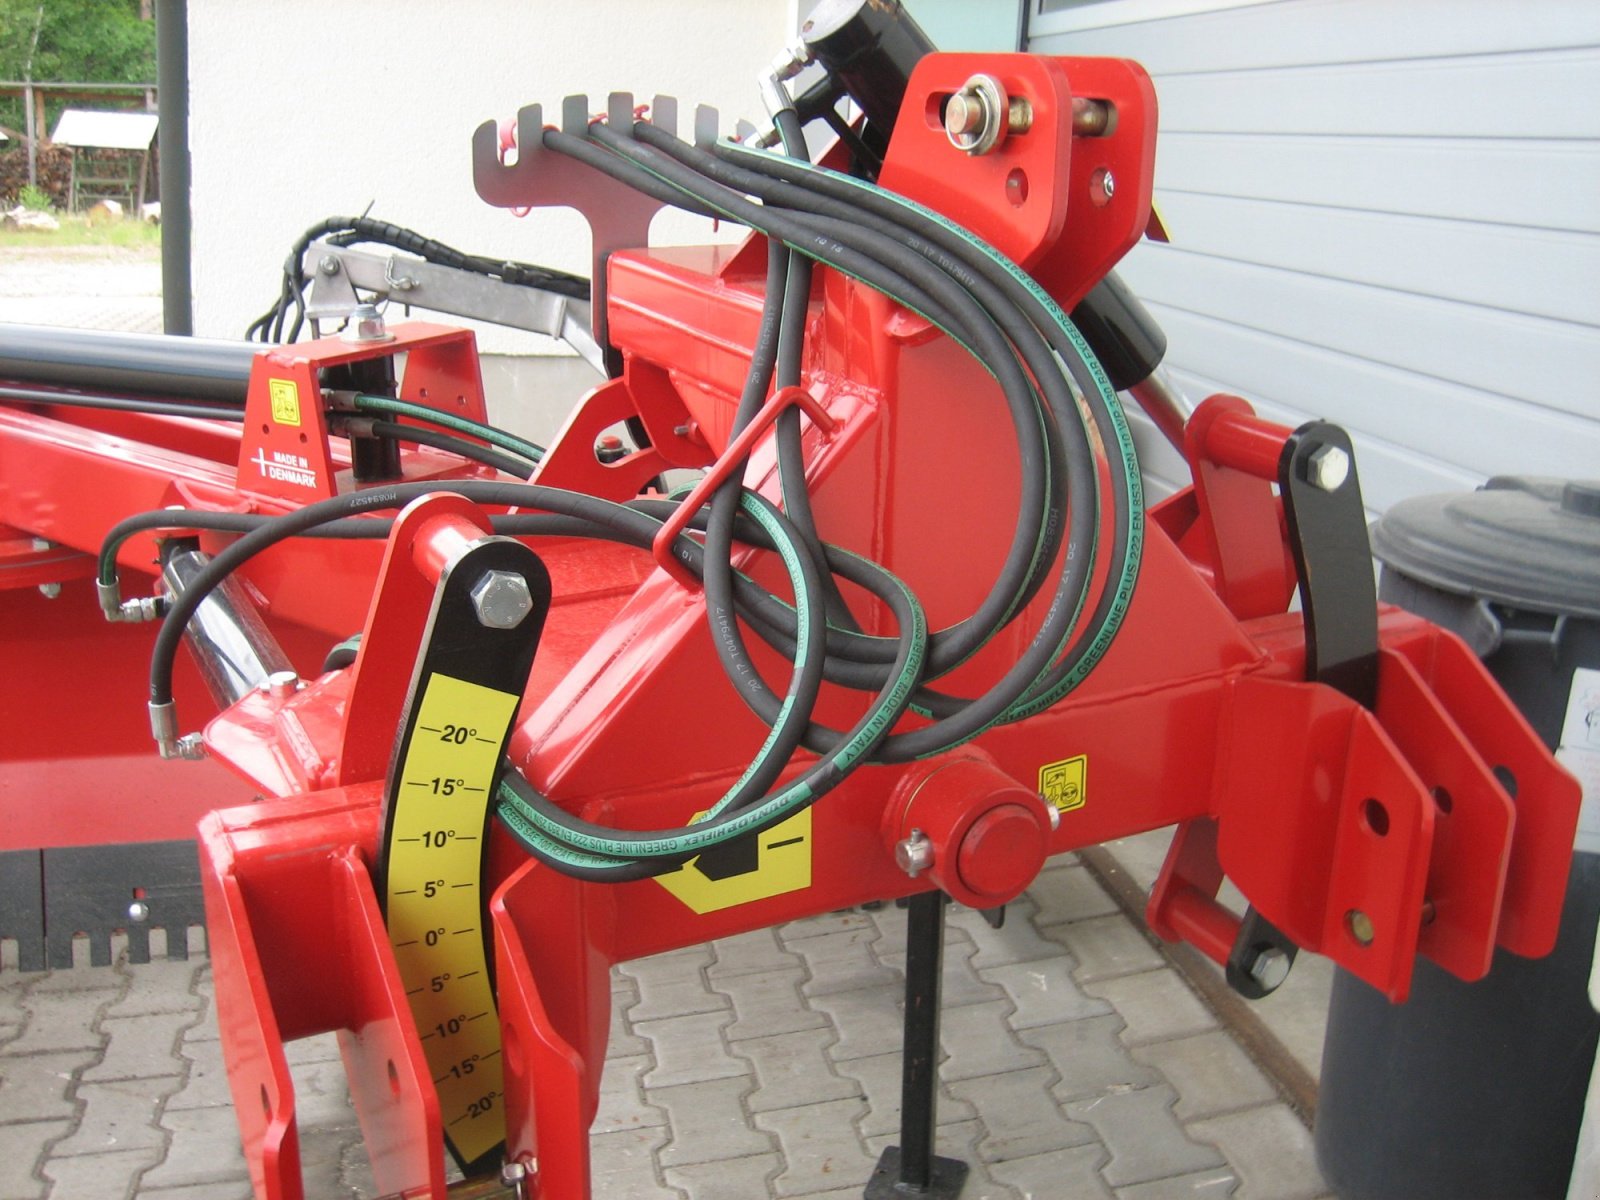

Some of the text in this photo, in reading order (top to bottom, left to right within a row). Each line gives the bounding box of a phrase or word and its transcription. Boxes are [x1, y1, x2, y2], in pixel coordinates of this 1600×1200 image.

[1027, 281, 1041, 295] 100
[1041, 295, 1059, 313] SAE
[1057, 313, 1092, 359] EXCEEDS
[1090, 362, 1108, 385] BAR
[1113, 411, 1127, 431] WP
[1121, 435, 1132, 449] 10
[273, 452, 308, 468] MADE IN
[1126, 452, 1139, 479] 2SN
[269, 466, 317, 488] DENMARK
[1132, 485, 1141, 506] 853
[1132, 512, 1142, 530] EN
[1130, 535, 1141, 561] 222
[1120, 565, 1137, 601] PLUS
[716, 607, 762, 692] 20 17 T0479417
[1077, 604, 1126, 675] GREENLINE
[883, 682, 908, 715] MADE
[872, 716, 886, 730] IN
[440, 725, 477, 745] 20°
[846, 730, 875, 761] ITALY
[431, 777, 465, 796] 15°
[727, 796, 789, 833] DUNLOP
[422, 829, 456, 848] 10°
[524, 826, 536, 841] SAE
[538, 836, 551, 849] 100
[561, 829, 573, 842] EN
[573, 833, 588, 846] 222
[683, 828, 726, 847] HIFLEX
[590, 839, 614, 853] PLUS
[616, 839, 678, 854] GREENLINE
[423, 879, 445, 898] 5°
[425, 927, 446, 946] 0°
[431, 973, 451, 992] 5°
[435, 1014, 467, 1038] 10°
[450, 1054, 480, 1079] 15°
[467, 1091, 497, 1119] 20°
